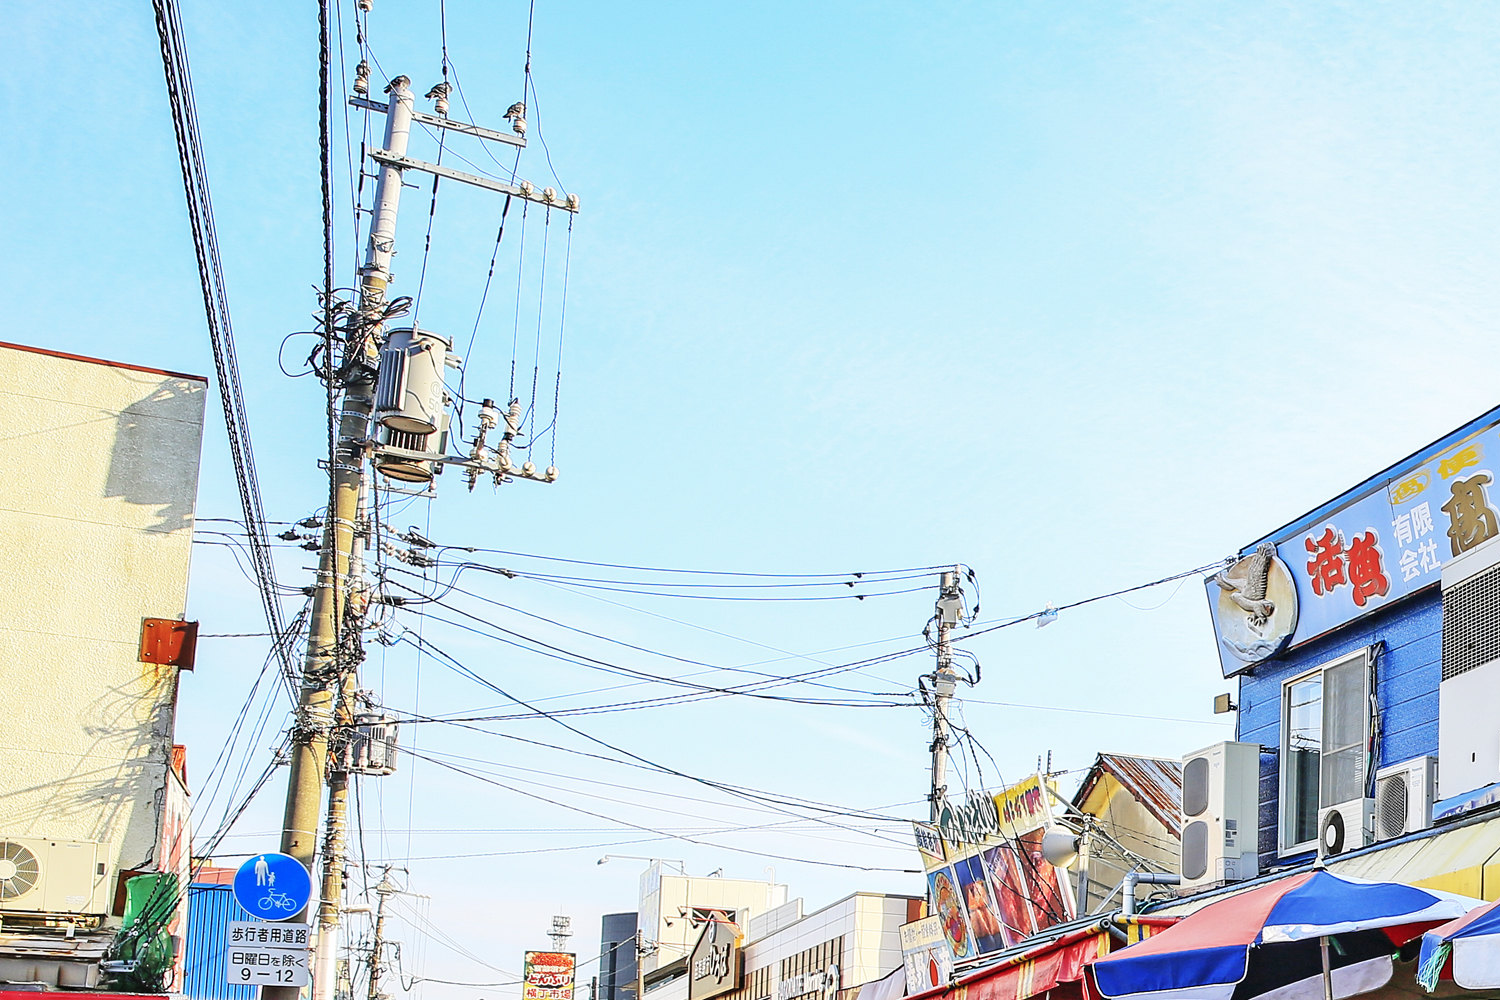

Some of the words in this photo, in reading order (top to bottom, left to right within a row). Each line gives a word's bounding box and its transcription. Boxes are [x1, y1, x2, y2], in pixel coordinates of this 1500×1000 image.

[1392, 501, 1434, 549] 有限
[1400, 538, 1441, 583] 会社
[232, 927, 307, 943] 歩行者用道路
[232, 952, 305, 968] 日曜日を除く
[529, 974, 570, 985] どんぶり
[527, 988, 571, 999] 横丁市場
